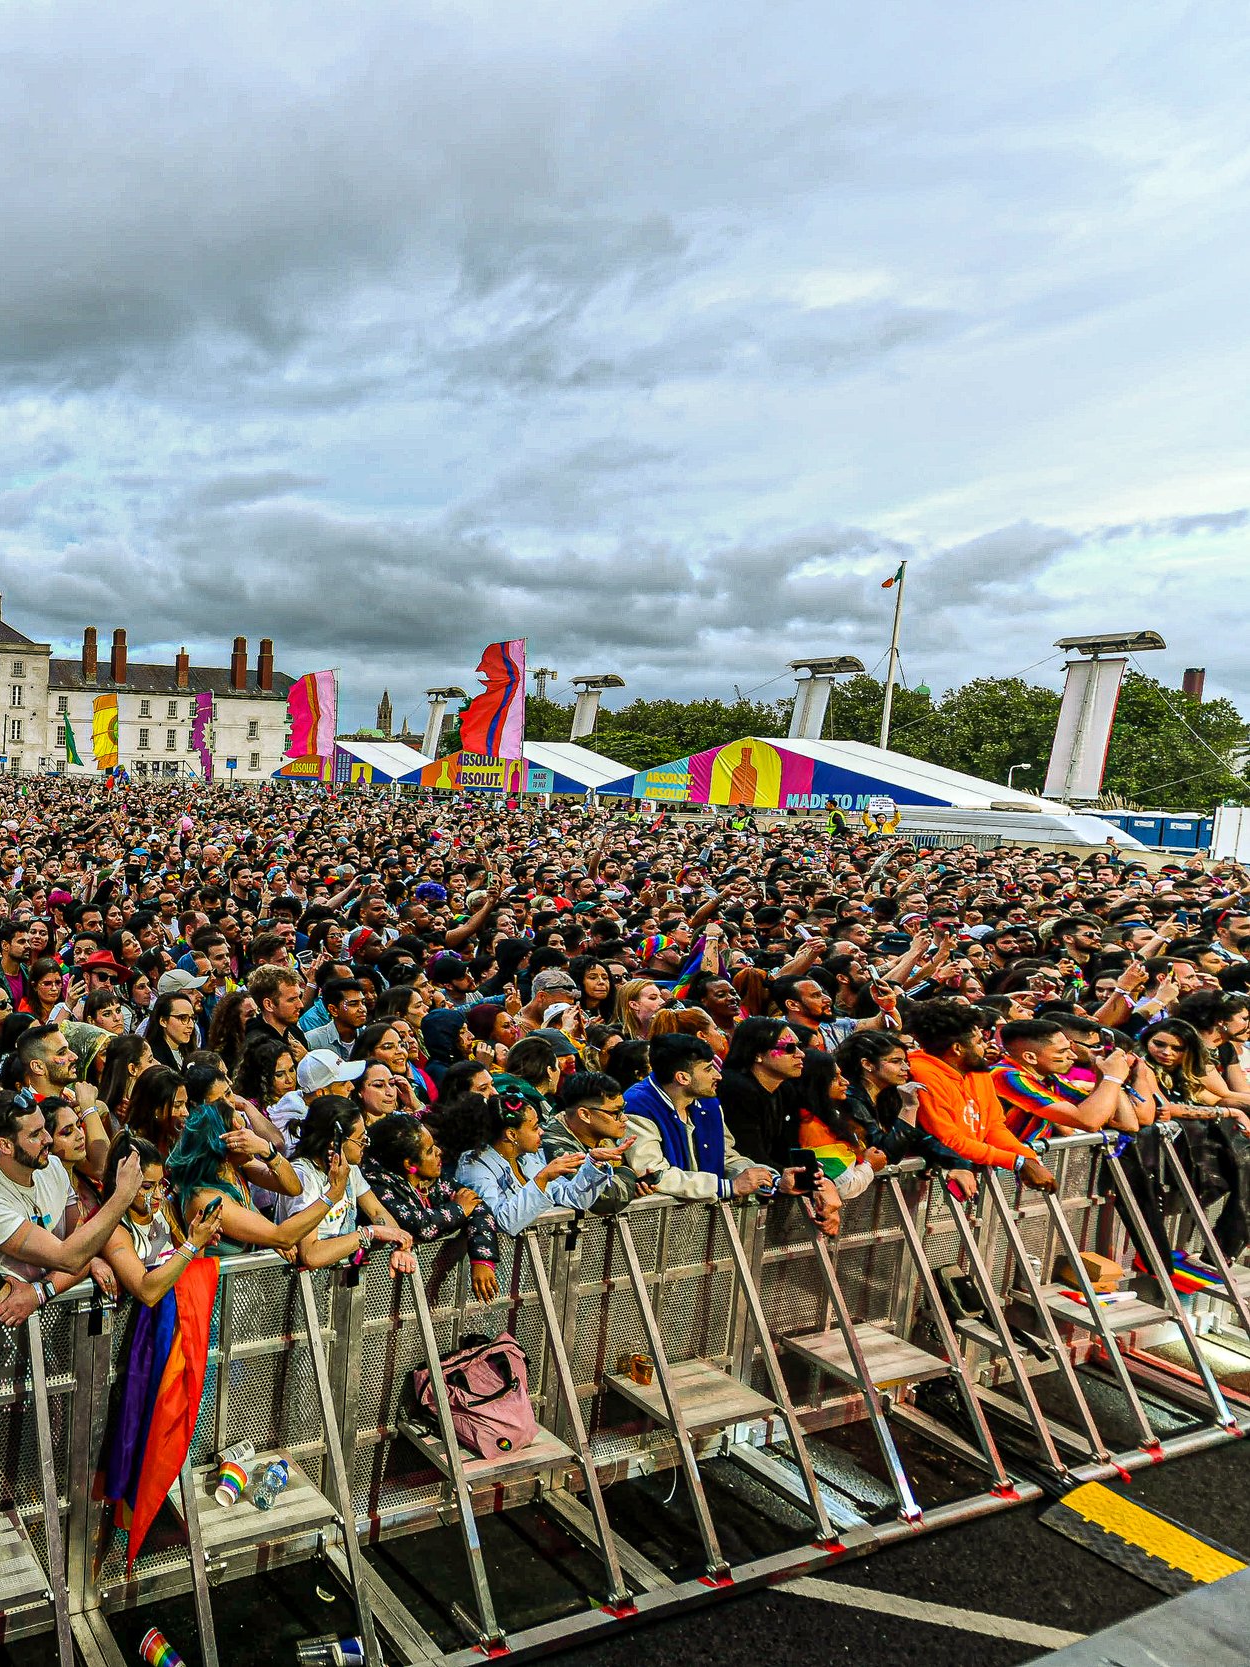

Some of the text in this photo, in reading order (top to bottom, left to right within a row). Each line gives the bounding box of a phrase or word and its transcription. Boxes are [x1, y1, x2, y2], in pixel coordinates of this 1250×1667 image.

[457, 754, 503, 767] ABSOLUT.
[291, 763, 318, 773] ABSOLUT.
[456, 772, 501, 786] ABSOLUT.
[646, 771, 694, 785] ABSOLUT.
[645, 787, 692, 801] ABSOLUT.
[786, 794, 829, 809] MADE
[833, 794, 852, 810] TO
